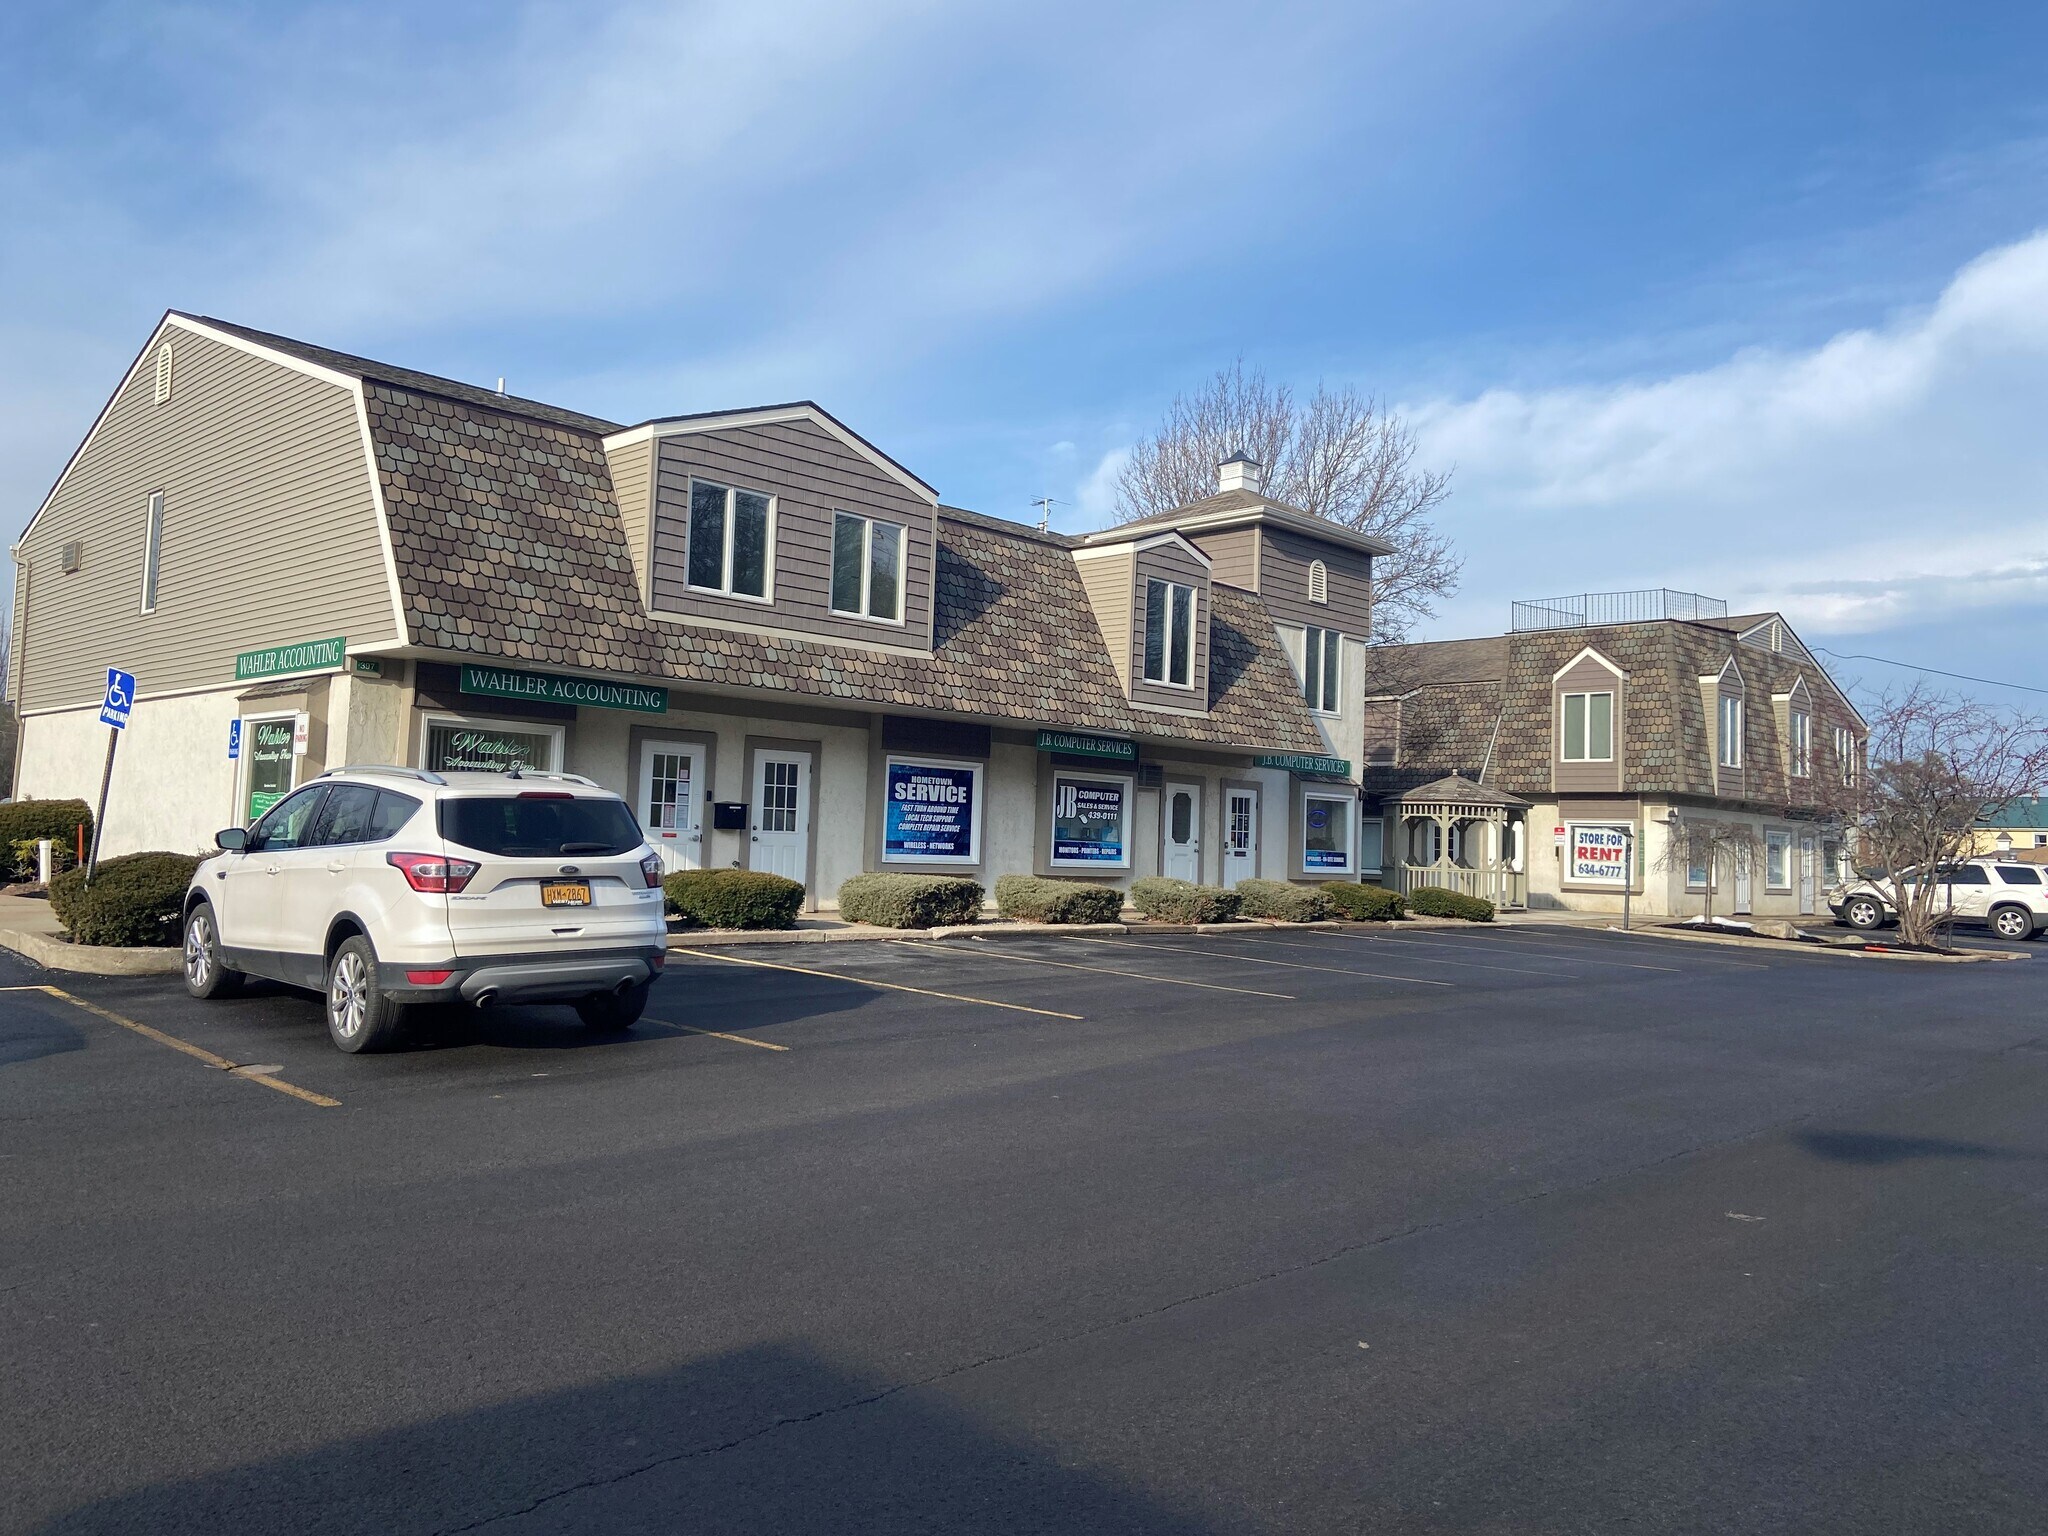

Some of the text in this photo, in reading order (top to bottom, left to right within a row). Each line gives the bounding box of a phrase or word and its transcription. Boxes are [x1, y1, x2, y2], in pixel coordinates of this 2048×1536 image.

[239, 641, 340, 675] WAHLER ACCOUNTING
[469, 670, 661, 708] WAHLER ACCOUNTING
[102, 706, 129, 723] PARKING
[257, 725, 291, 745] Wahler
[451, 731, 530, 756] Wahler
[1054, 735, 1096, 751] COMPUTER
[1097, 740, 1132, 755] SERVICES
[443, 756, 507, 773] Accounting
[1275, 755, 1313, 770] COMPUTER
[1315, 758, 1345, 774] SERVICES
[911, 776, 953, 785] HOMETOWN
[894, 782, 967, 803] SERVICE
[1078, 790, 1119, 802] COMPUTER
[900, 804, 914, 812] FAST
[1056, 785, 1078, 818] JB
[898, 823, 924, 831] COMPLETE
[932, 815, 955, 823] SUPPORT
[903, 841, 927, 849] WIRELESS
[929, 842, 955, 850] NETWORKS
[1580, 832, 1623, 846] STORE FOR
[1577, 846, 1623, 861] RENT
[1578, 863, 1622, 877] 634-6777
